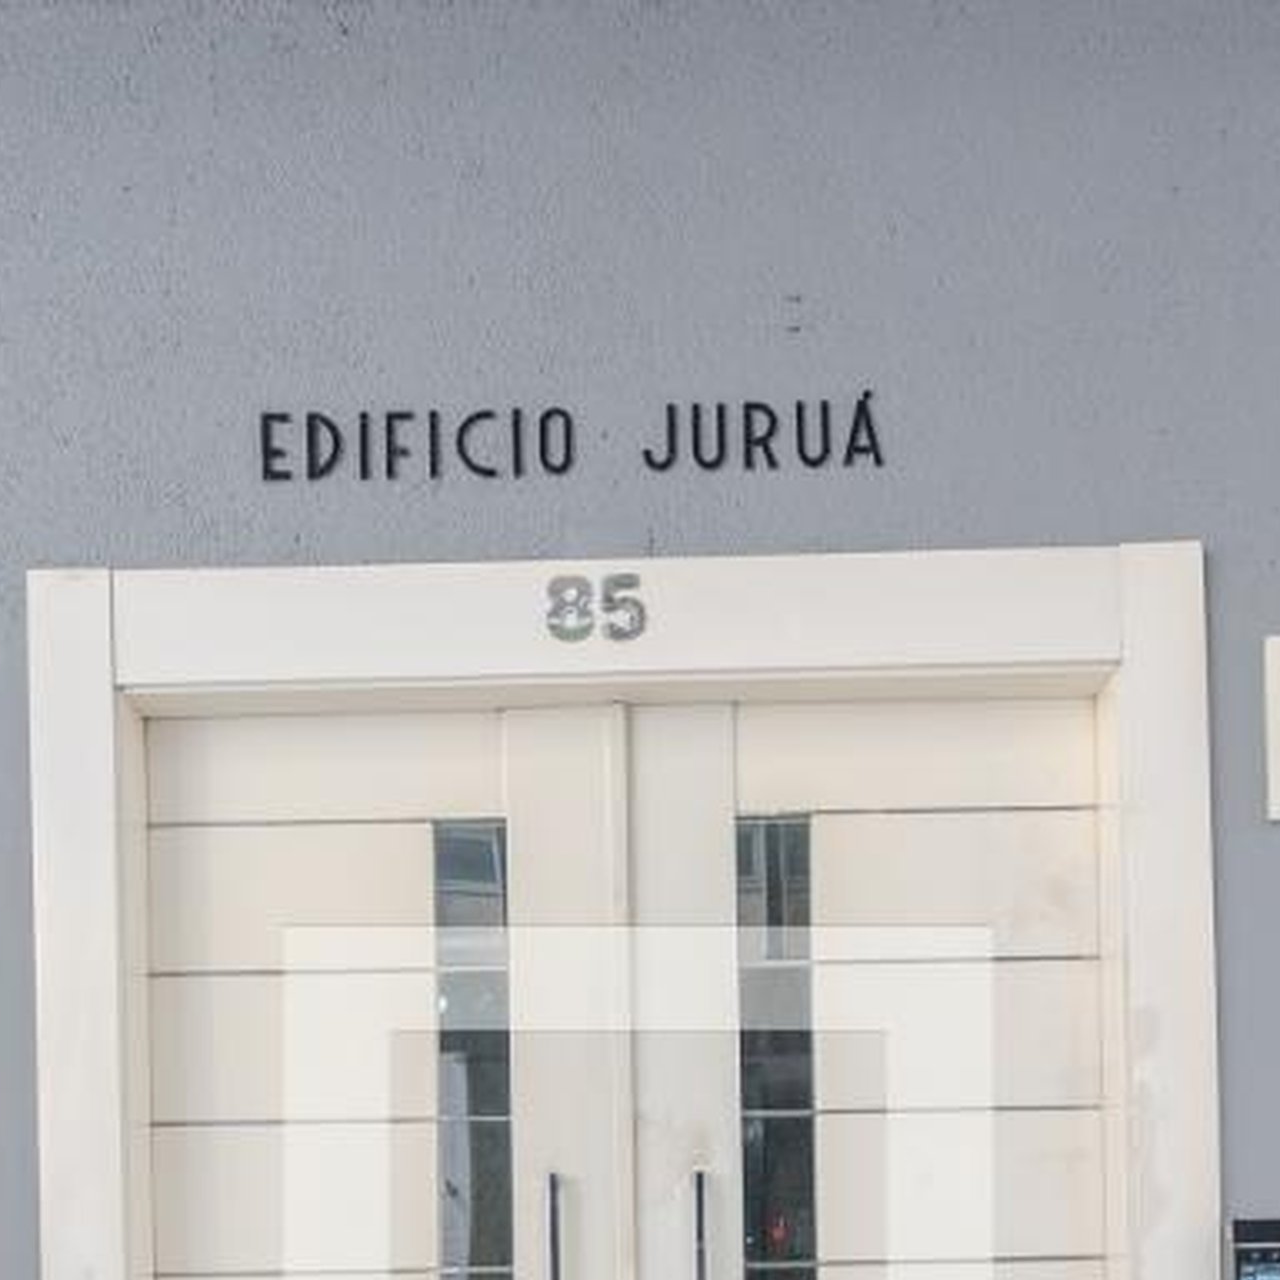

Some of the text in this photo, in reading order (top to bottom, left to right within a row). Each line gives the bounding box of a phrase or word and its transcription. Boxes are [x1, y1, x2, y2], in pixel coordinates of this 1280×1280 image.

[260, 390, 884, 481] EDIFICIO JURUÁ
[546, 574, 646, 643] 85
